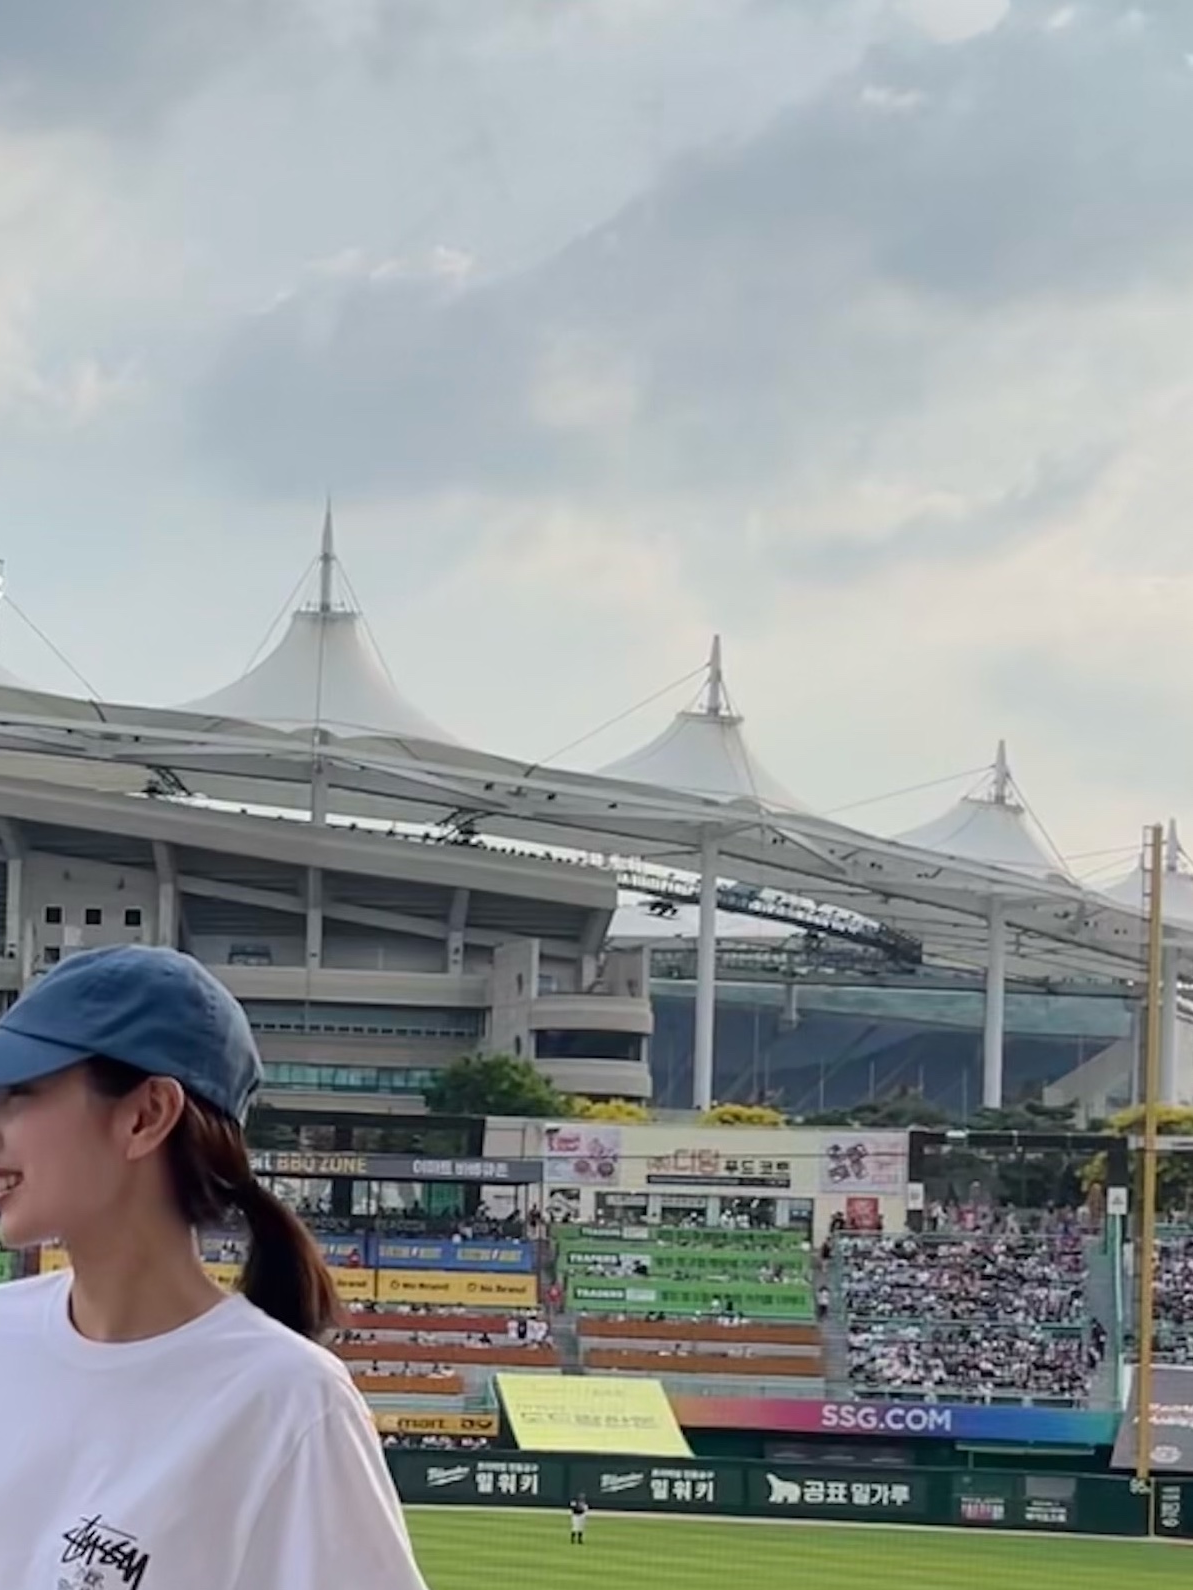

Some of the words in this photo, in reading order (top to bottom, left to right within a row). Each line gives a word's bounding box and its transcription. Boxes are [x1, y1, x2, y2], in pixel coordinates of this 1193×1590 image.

[821, 1404, 952, 1432] SSG.COM
[803, 1480, 847, 1504] 곰표
[850, 1481, 911, 1507] 밀가루
